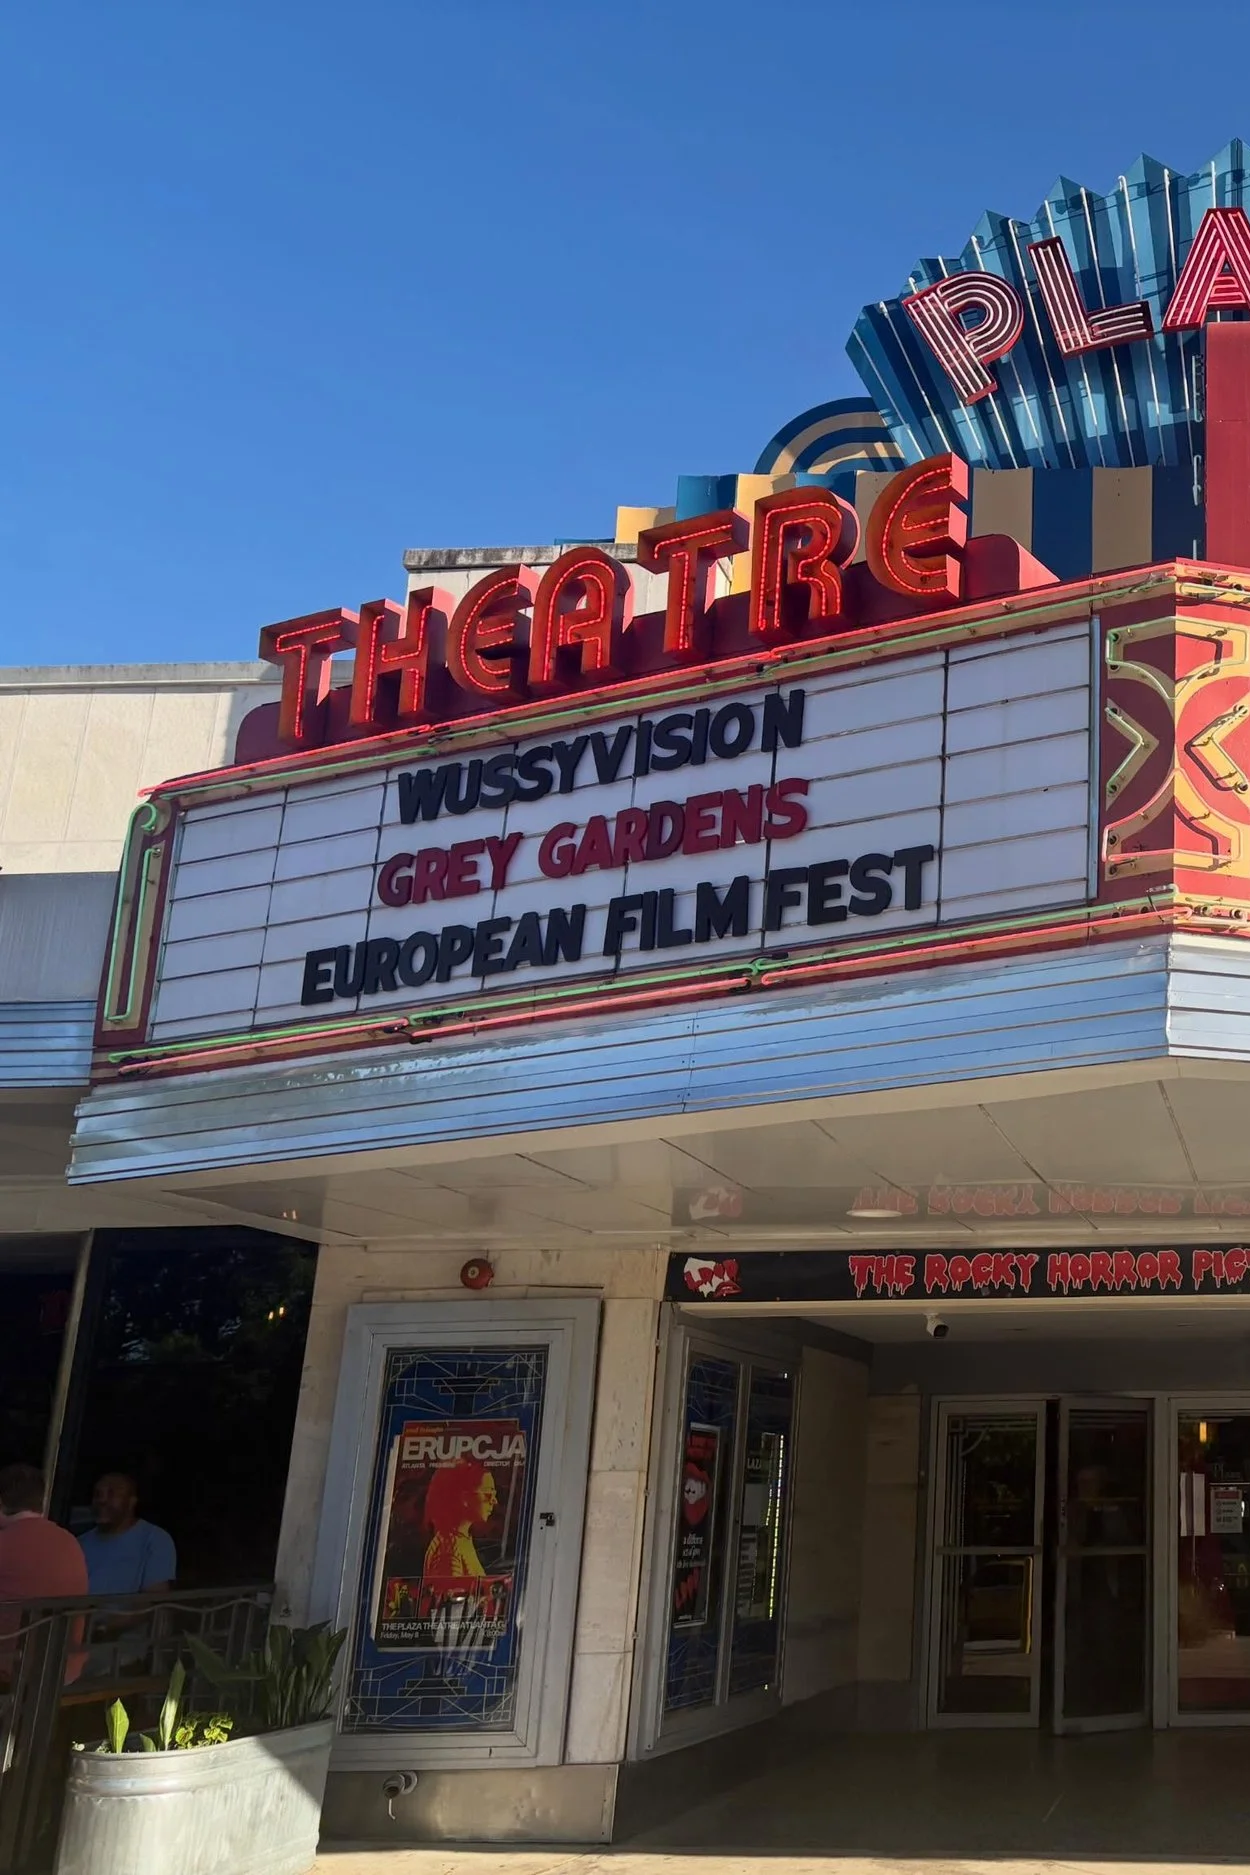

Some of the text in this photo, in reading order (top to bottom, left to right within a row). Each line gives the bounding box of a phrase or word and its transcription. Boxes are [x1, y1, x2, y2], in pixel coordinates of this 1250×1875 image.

[259, 452, 968, 741] THEATRE
[377, 778, 810, 908] GREY GARDENS
[300, 844, 934, 1005] EUROPEAN FILM FEST
[848, 1254, 915, 1297] THE
[924, 1253, 1040, 1293] ROCKY
[1047, 1250, 1183, 1293] HORROR
[402, 1434, 526, 1461] ERUPCJA
[382, 1623, 398, 1631] THE
[398, 1622, 422, 1631] PLAZA
